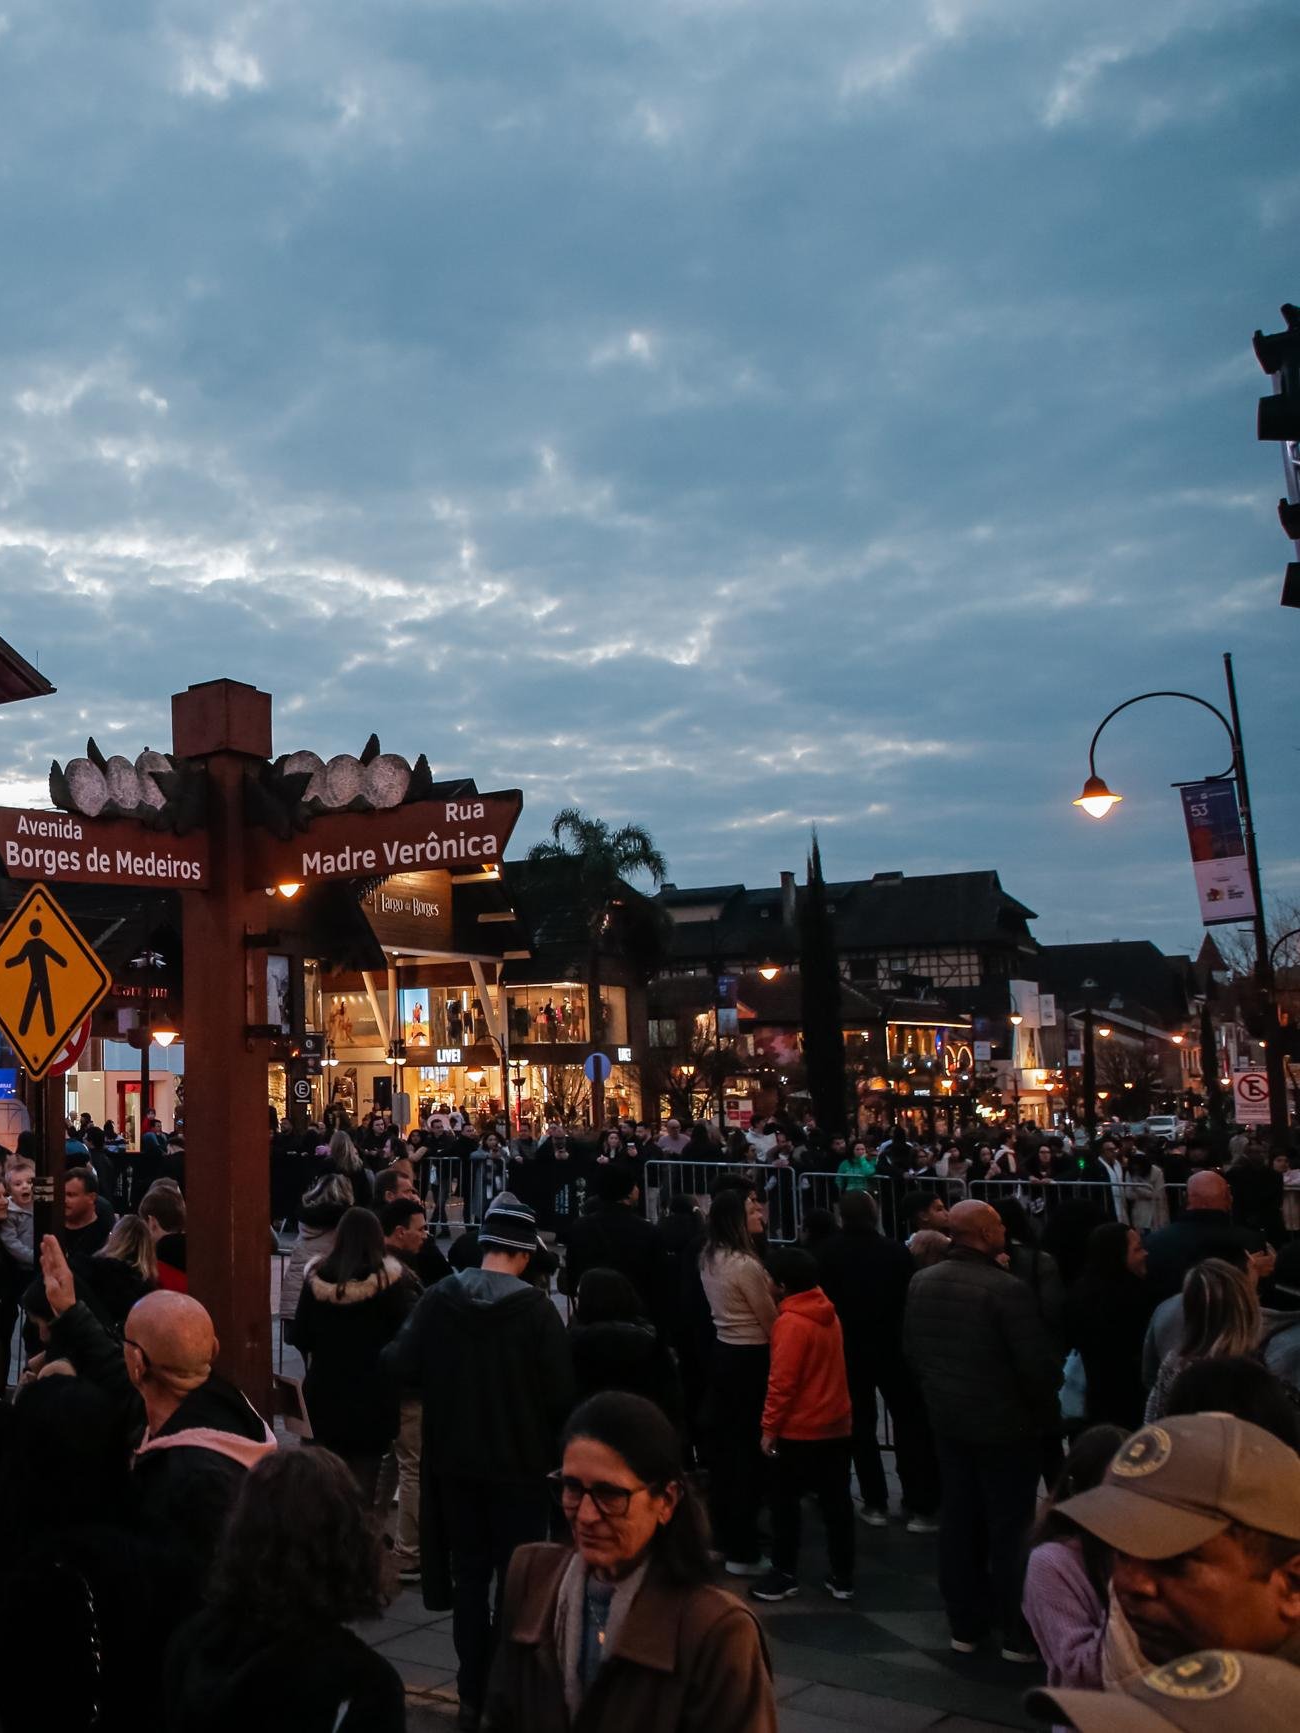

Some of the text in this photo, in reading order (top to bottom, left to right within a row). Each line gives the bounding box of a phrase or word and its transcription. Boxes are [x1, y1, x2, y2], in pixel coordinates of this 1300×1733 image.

[446, 802, 485, 822] Rua
[1190, 803, 1208, 817] 53
[17, 815, 83, 840] Avenida
[6, 840, 201, 880] Borges de Medeiros
[302, 831, 498, 876] Madre Verônica
[381, 893, 403, 913] Largo
[412, 898, 439, 918] Borges
[436, 1048, 461, 1063] LIVE!
